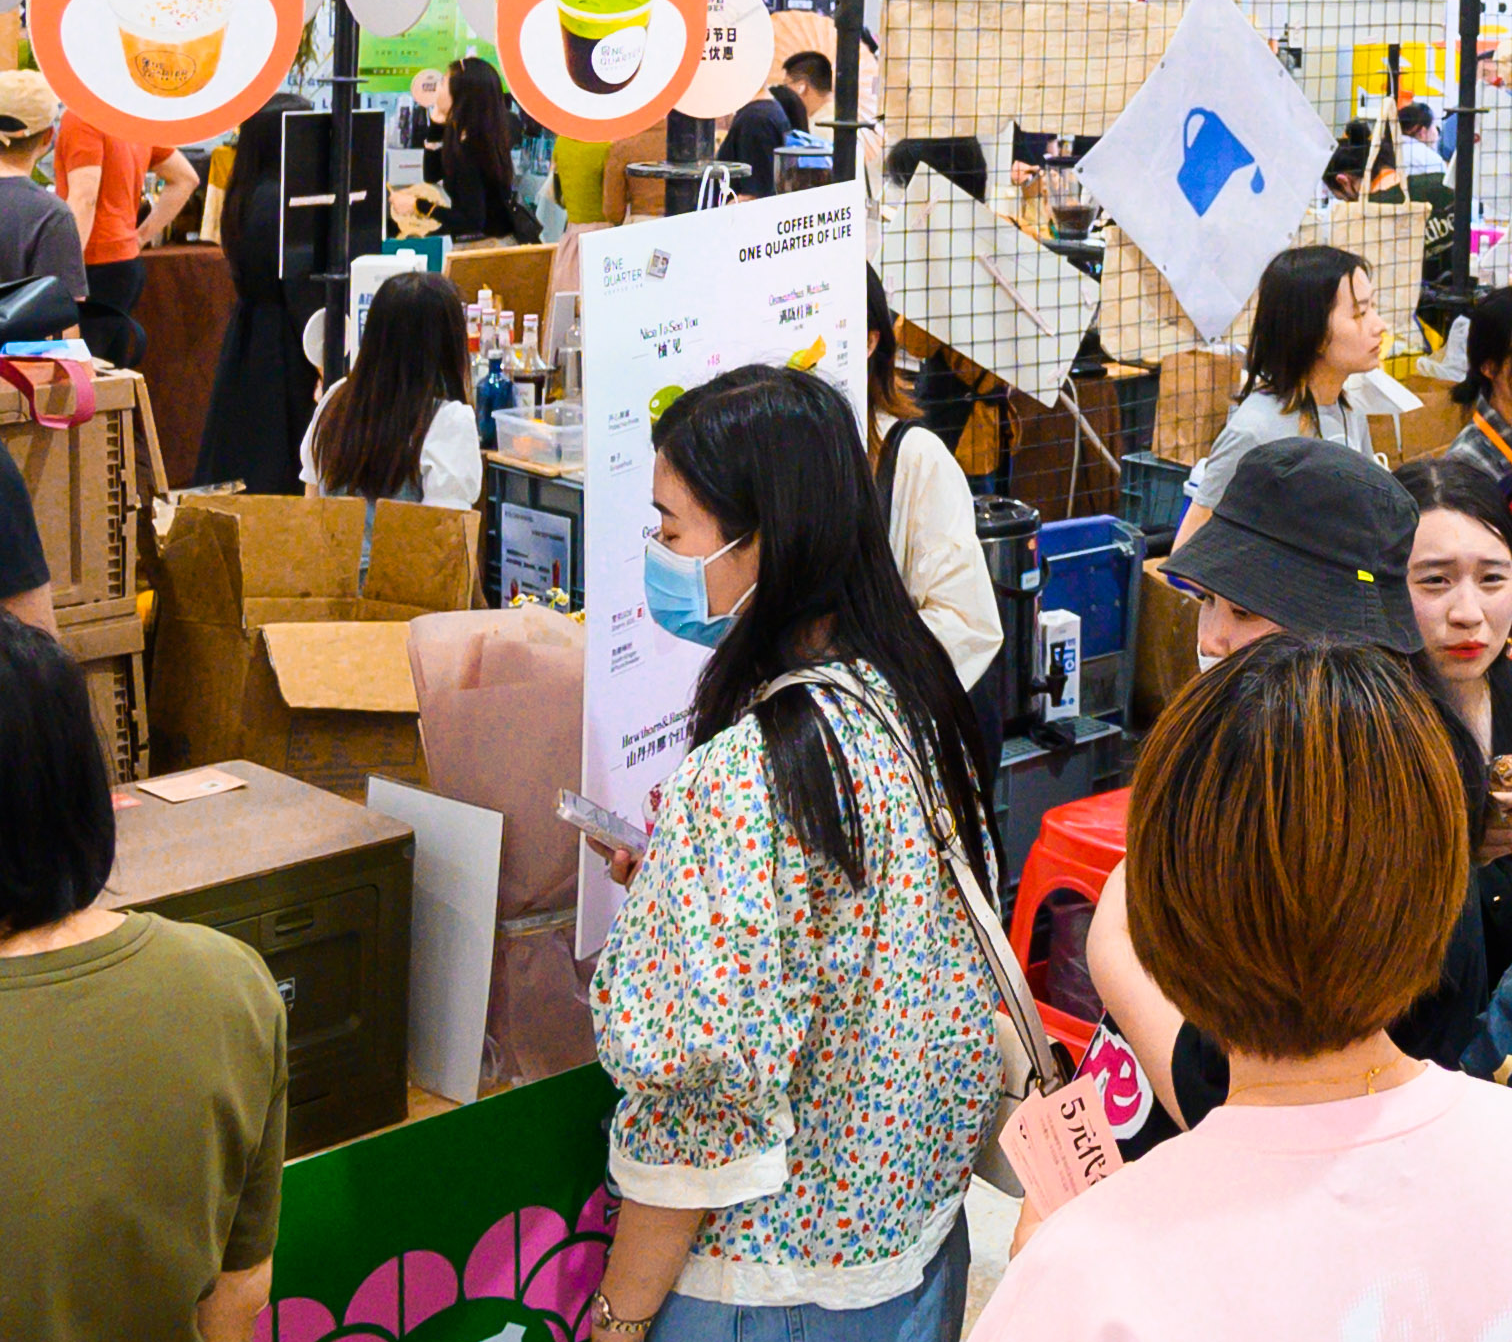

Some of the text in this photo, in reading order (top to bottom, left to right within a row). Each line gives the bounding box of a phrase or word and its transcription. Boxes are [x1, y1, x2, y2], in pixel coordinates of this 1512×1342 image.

[777, 206, 852, 236] COFFEE MAKES
[739, 223, 852, 263] ONE QUARTER OF LIFE
[603, 268, 643, 288] QUARTER
